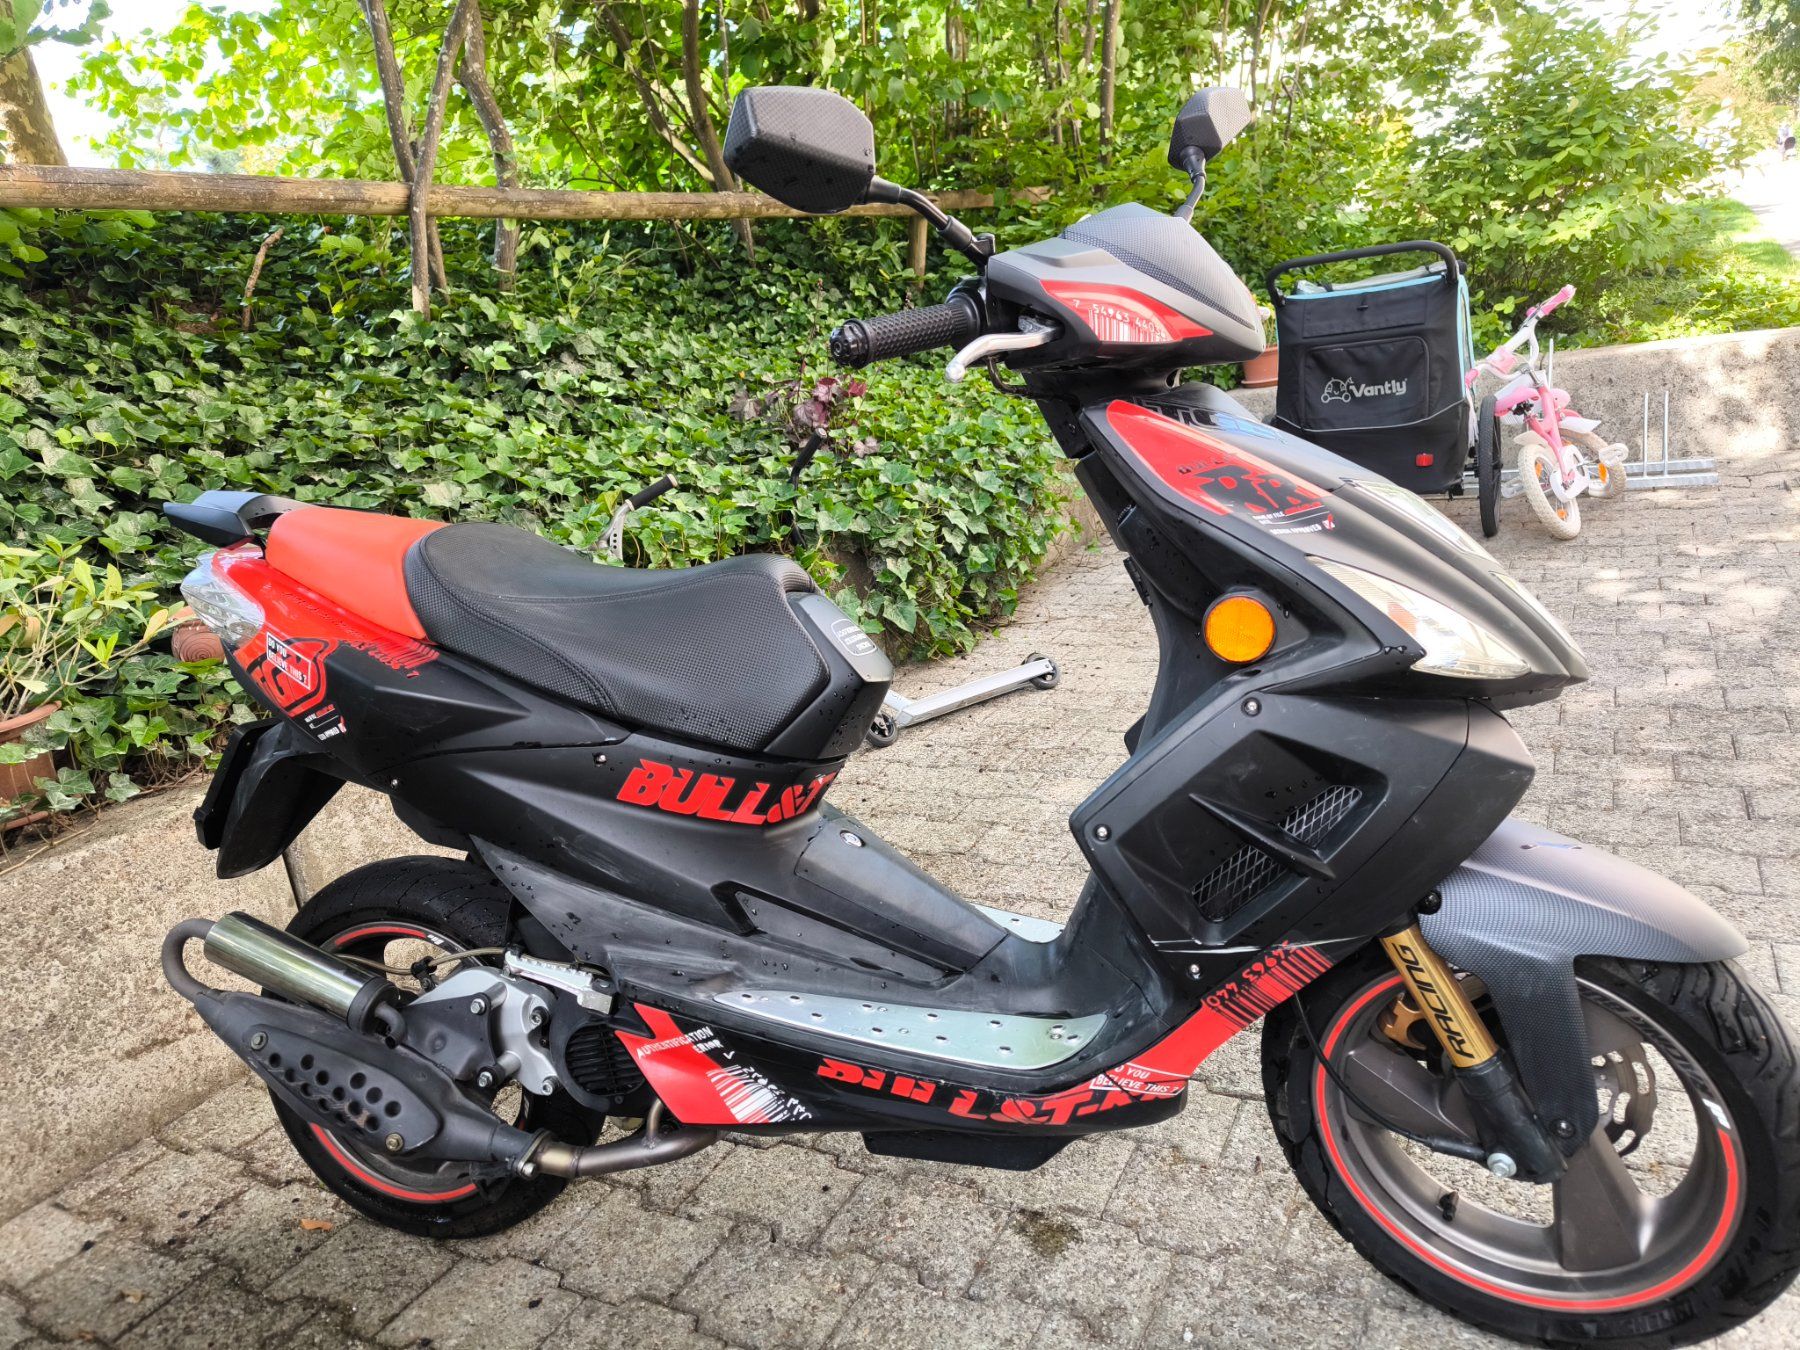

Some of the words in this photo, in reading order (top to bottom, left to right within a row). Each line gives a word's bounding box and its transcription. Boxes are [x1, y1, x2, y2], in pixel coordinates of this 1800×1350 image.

[1349, 379, 1407, 398] Vantly
[1391, 942, 1476, 1059] RACING
[1126, 1067, 1151, 1080] YOU
[1144, 1082, 1169, 1094] THIS
